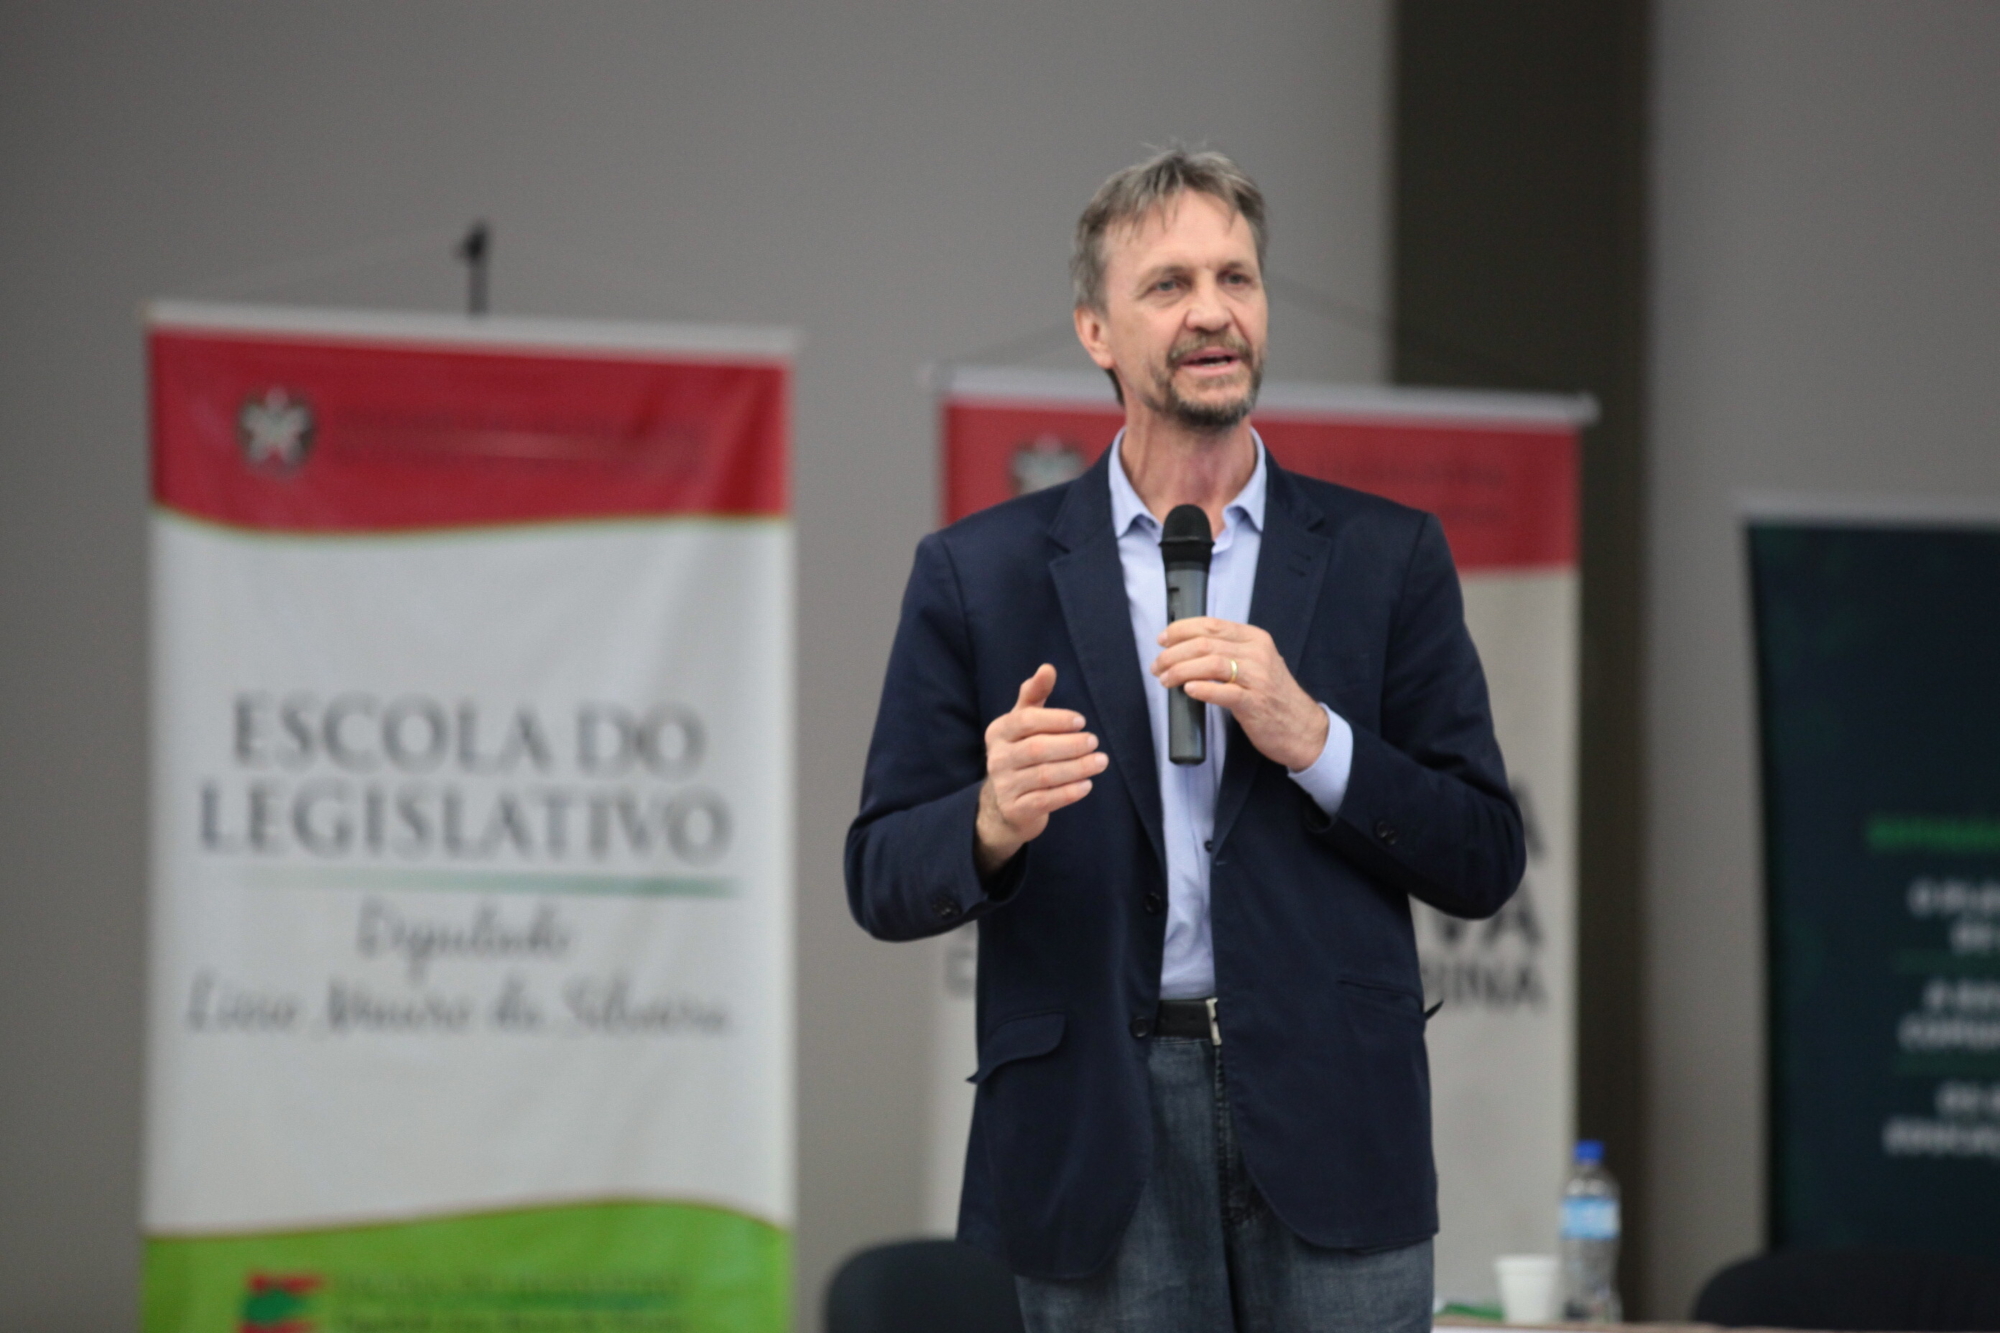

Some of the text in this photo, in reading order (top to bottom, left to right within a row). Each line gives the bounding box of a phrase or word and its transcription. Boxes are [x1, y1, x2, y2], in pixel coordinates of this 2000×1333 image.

[233, 691, 709, 782] ESCOLA DO
[199, 778, 736, 868] LEGISLATIVO
